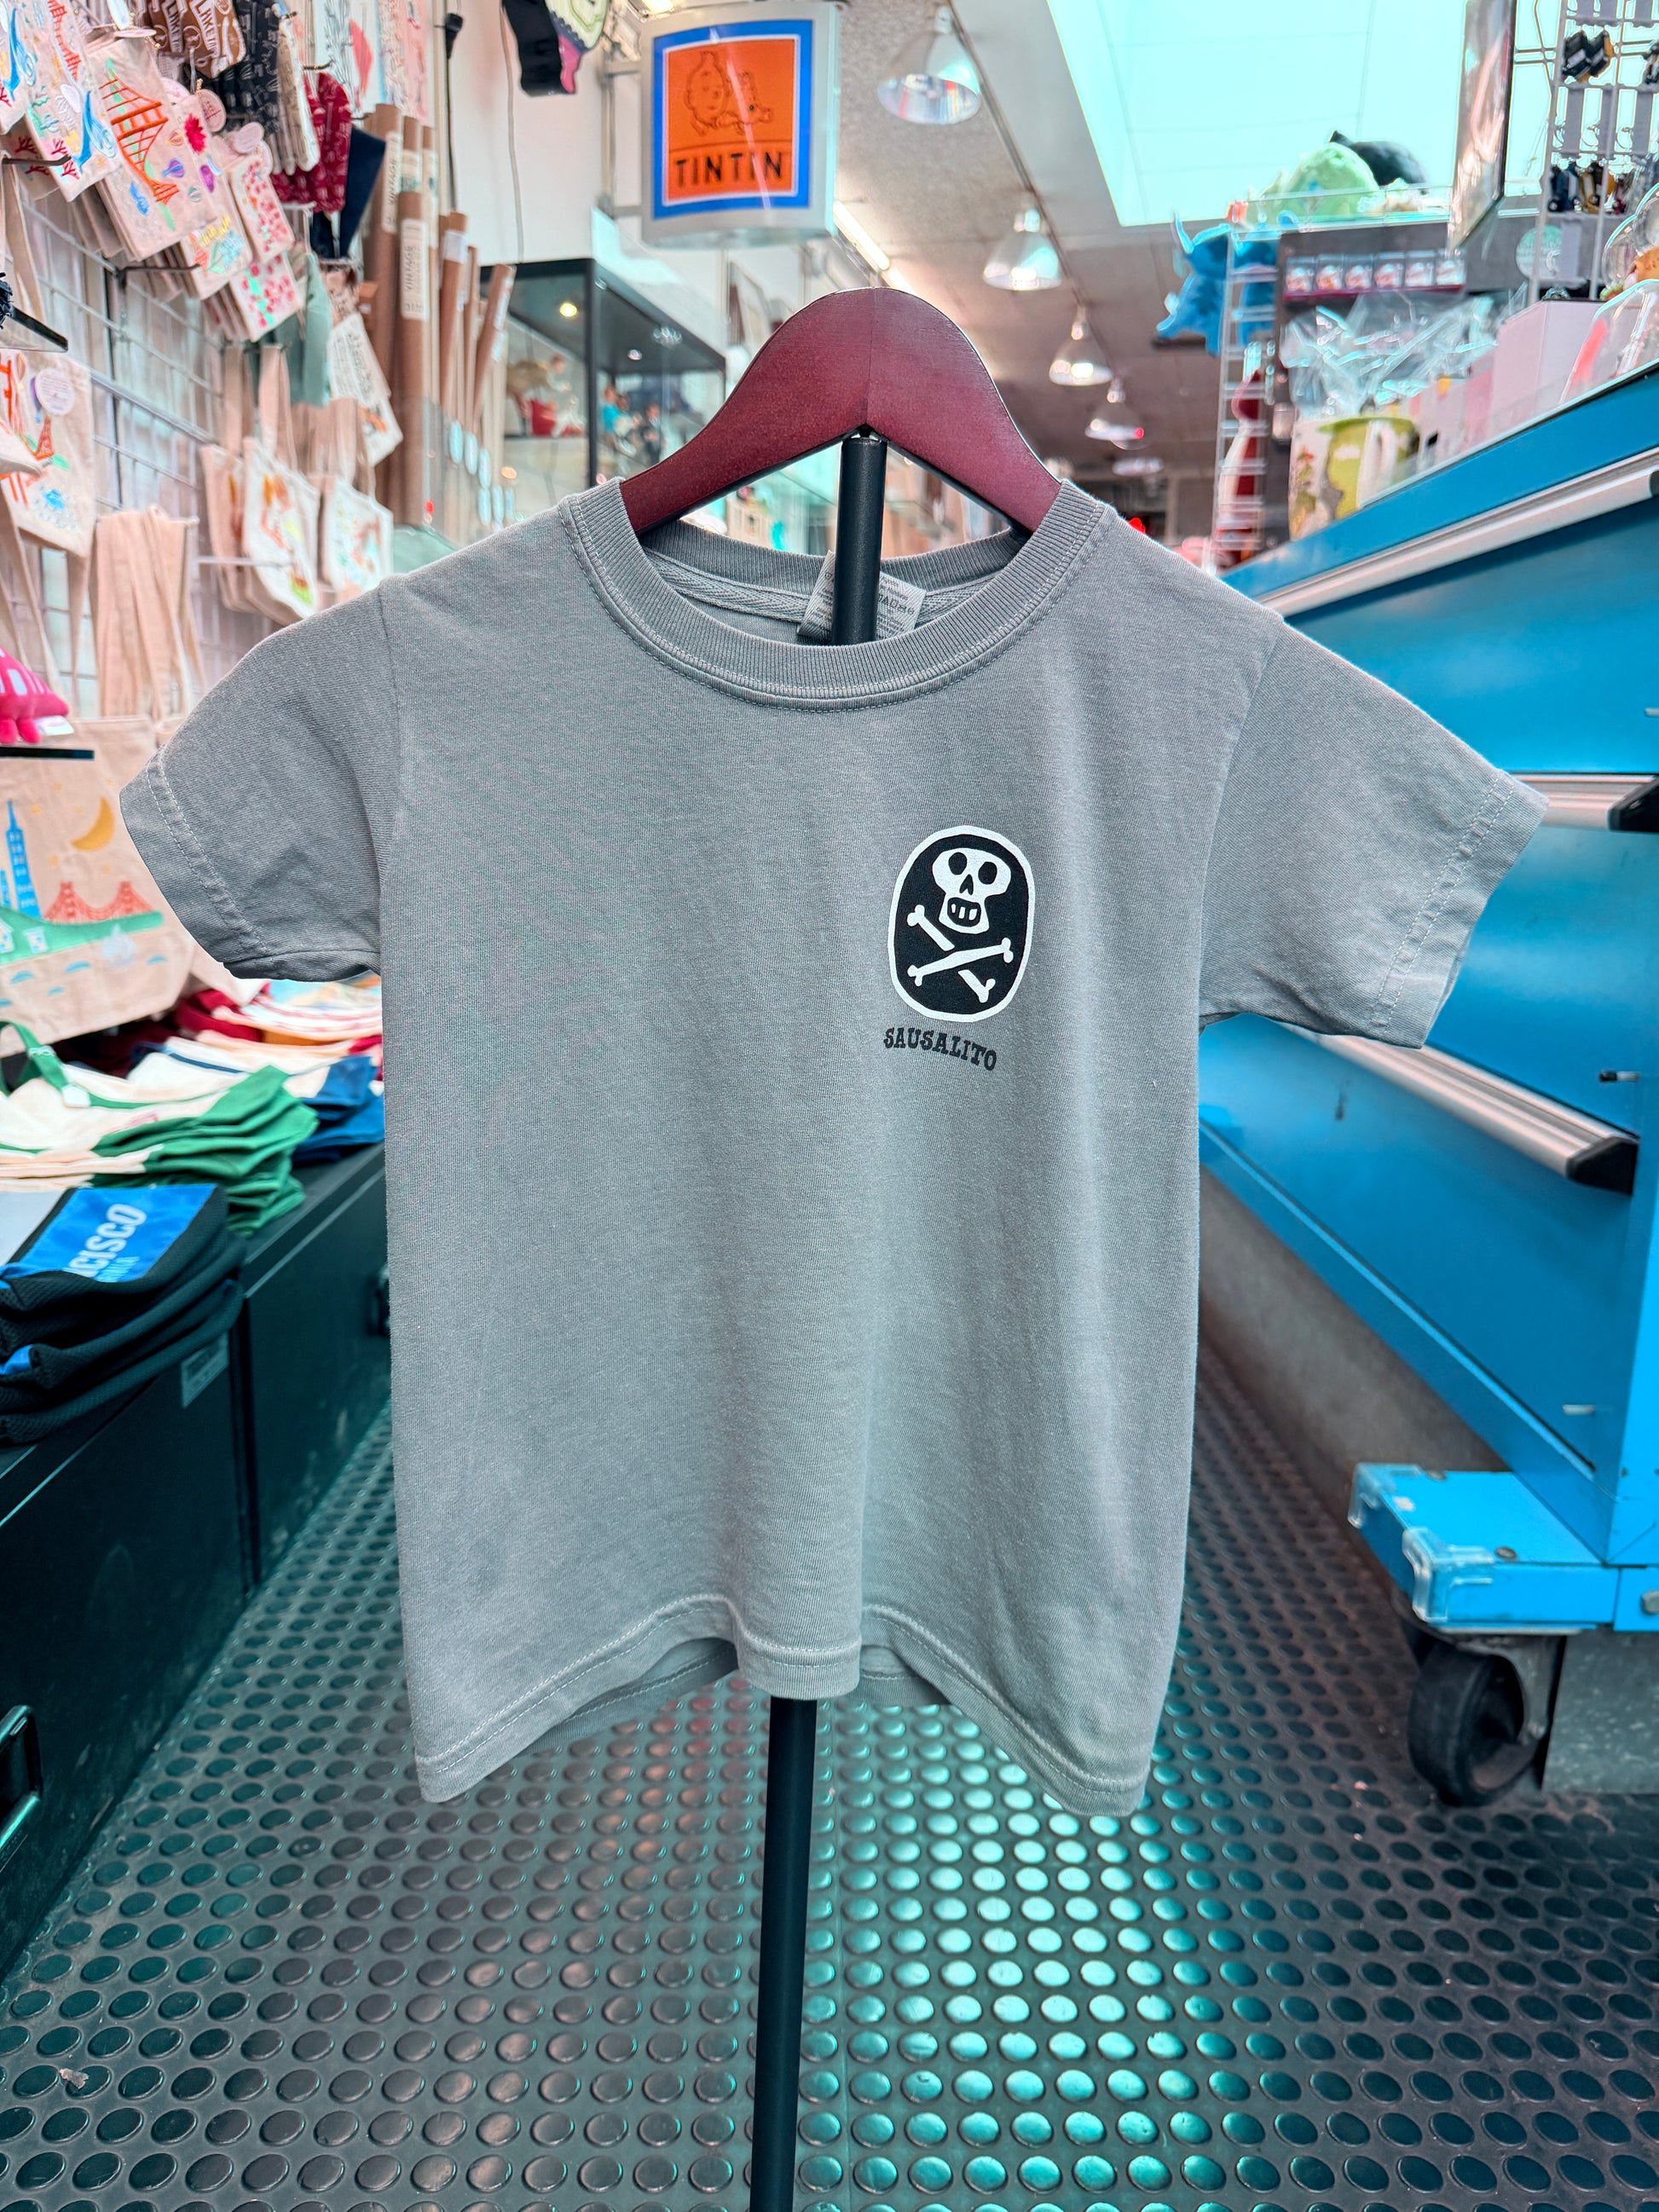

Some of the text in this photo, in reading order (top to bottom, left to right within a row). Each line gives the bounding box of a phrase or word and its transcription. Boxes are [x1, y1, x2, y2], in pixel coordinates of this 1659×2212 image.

[675, 152, 783, 188] TINTIN
[404, 245, 414, 293] VINTAGE
[883, 1026, 997, 1071] SAUSALITO
